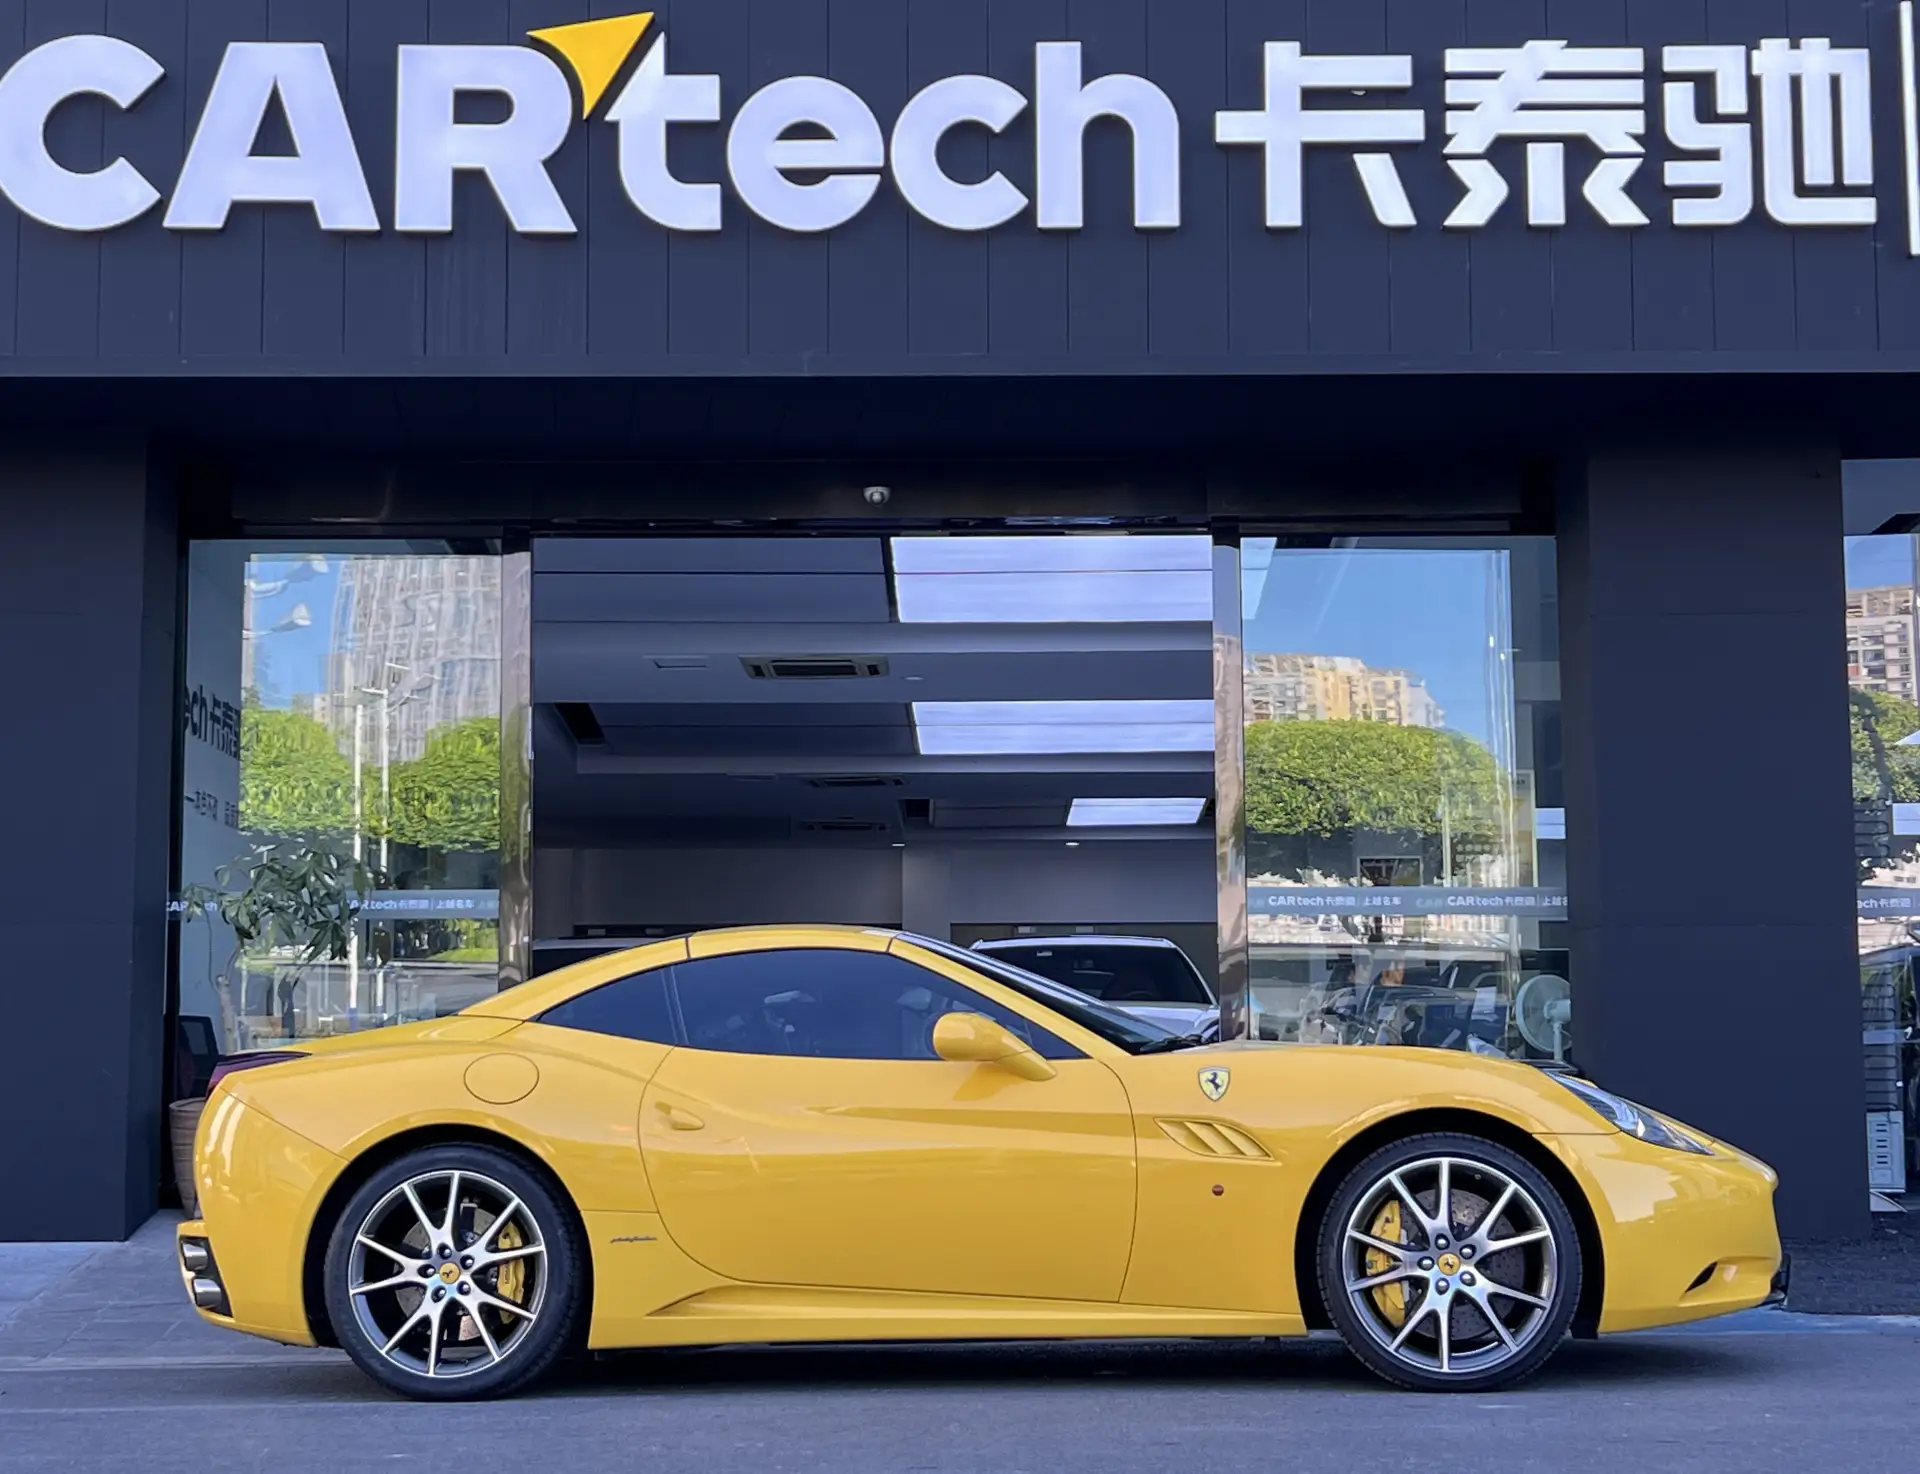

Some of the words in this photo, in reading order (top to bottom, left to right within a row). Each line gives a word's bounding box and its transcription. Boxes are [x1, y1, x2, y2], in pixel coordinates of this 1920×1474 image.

[0, 32, 1181, 233] CARtech
[1214, 38, 1878, 229] 卡泰驰
[1268, 895, 1325, 907] CARtech
